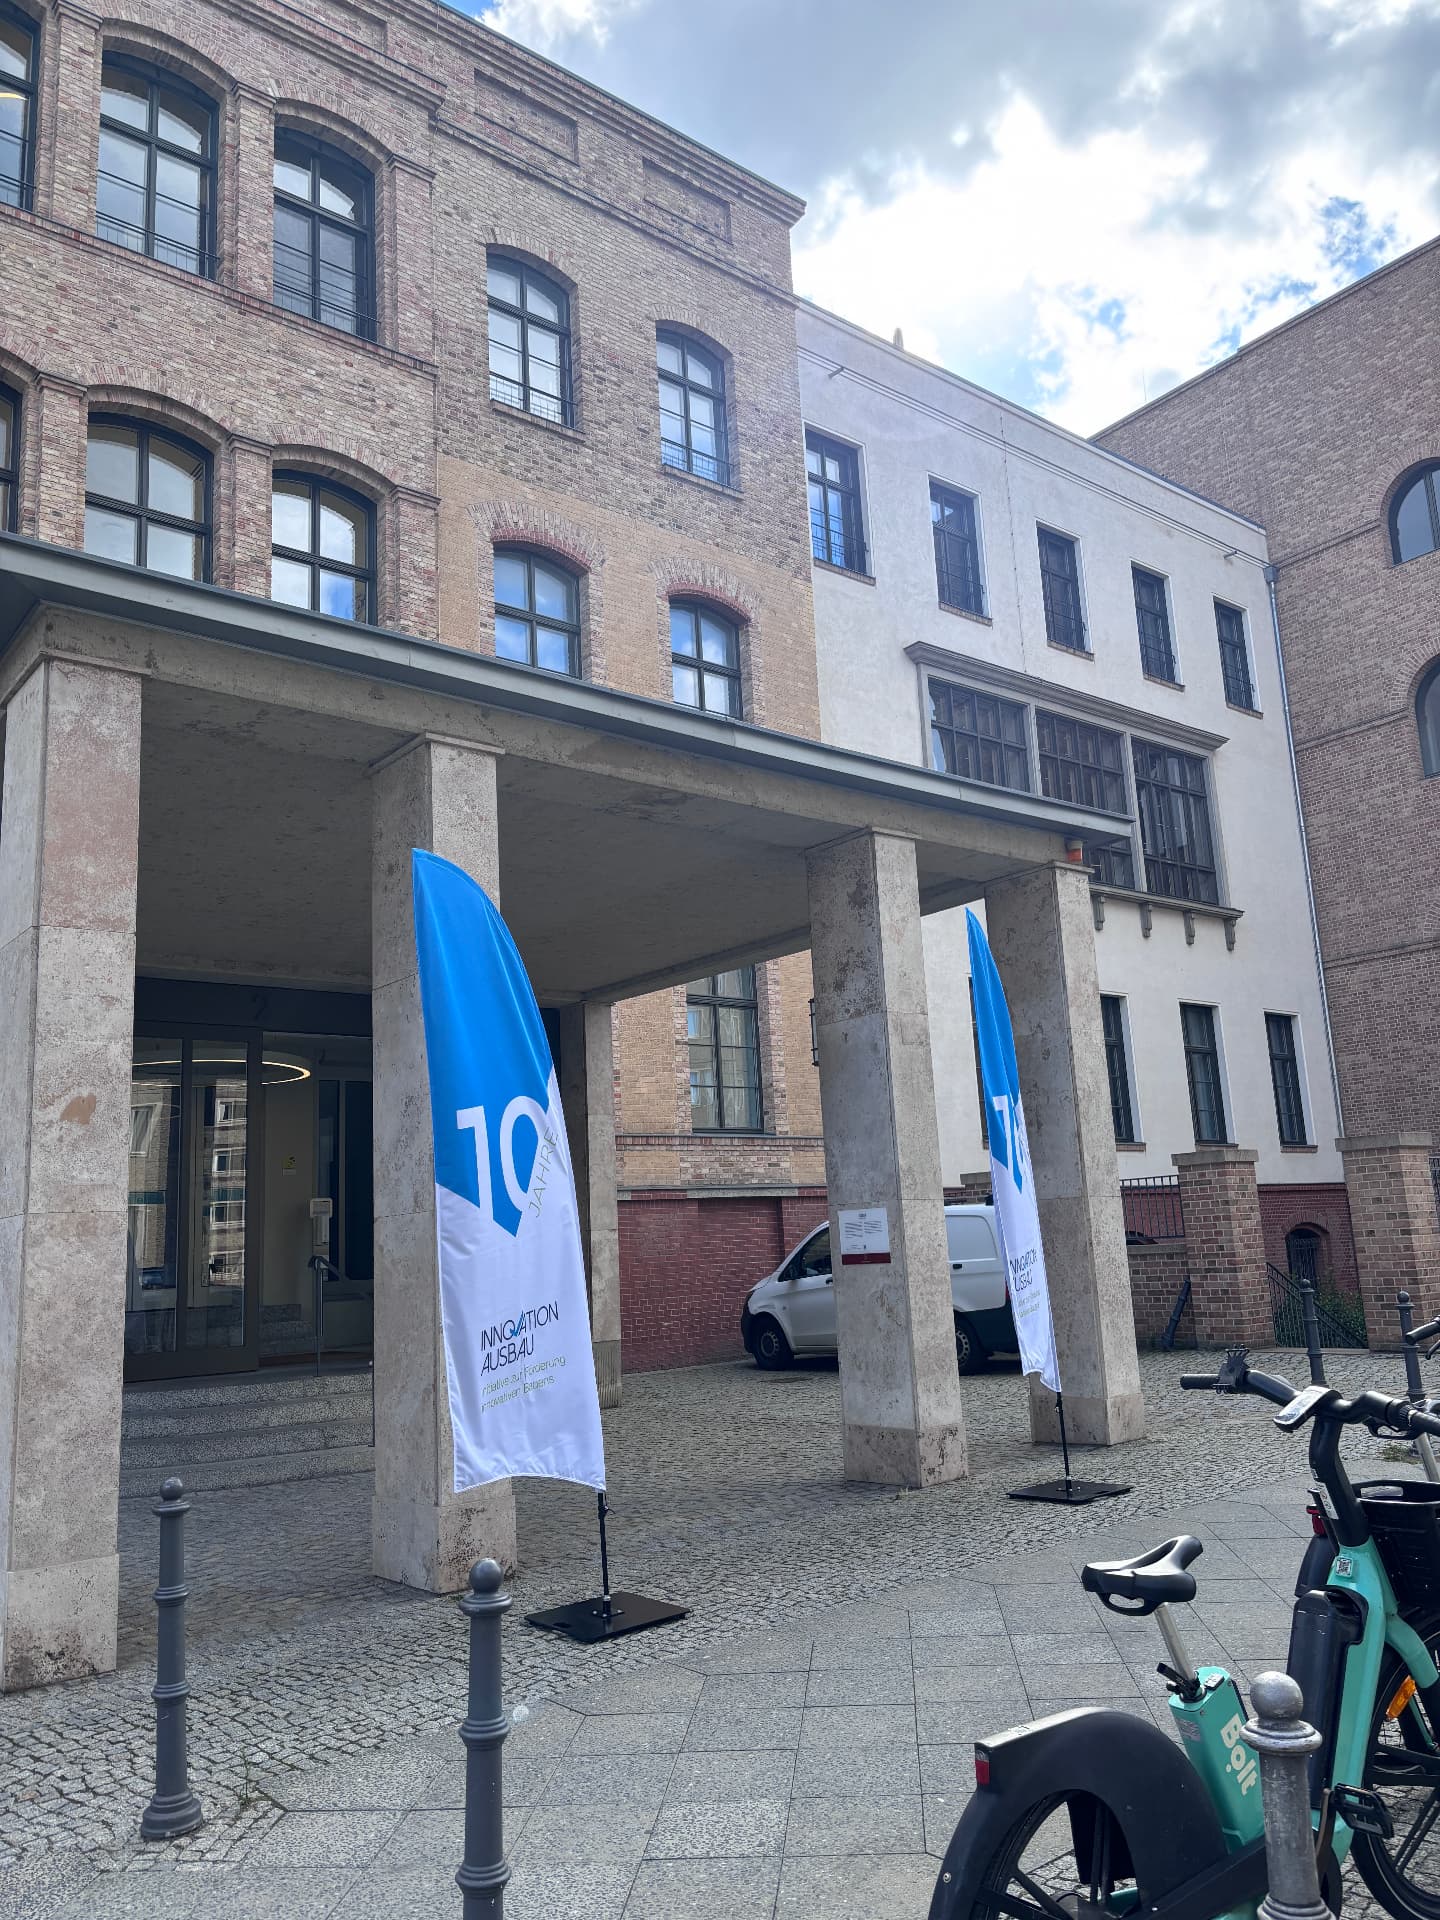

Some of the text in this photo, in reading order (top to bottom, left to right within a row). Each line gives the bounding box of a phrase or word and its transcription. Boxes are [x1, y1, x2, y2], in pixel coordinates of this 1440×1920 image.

[456, 1096, 548, 1220] 10
[528, 1127, 558, 1218] JAHRE
[480, 1300, 559, 1351] INNOVATION
[480, 1334, 534, 1377] AUSBAU
[1221, 1713, 1257, 1796] Bolt
